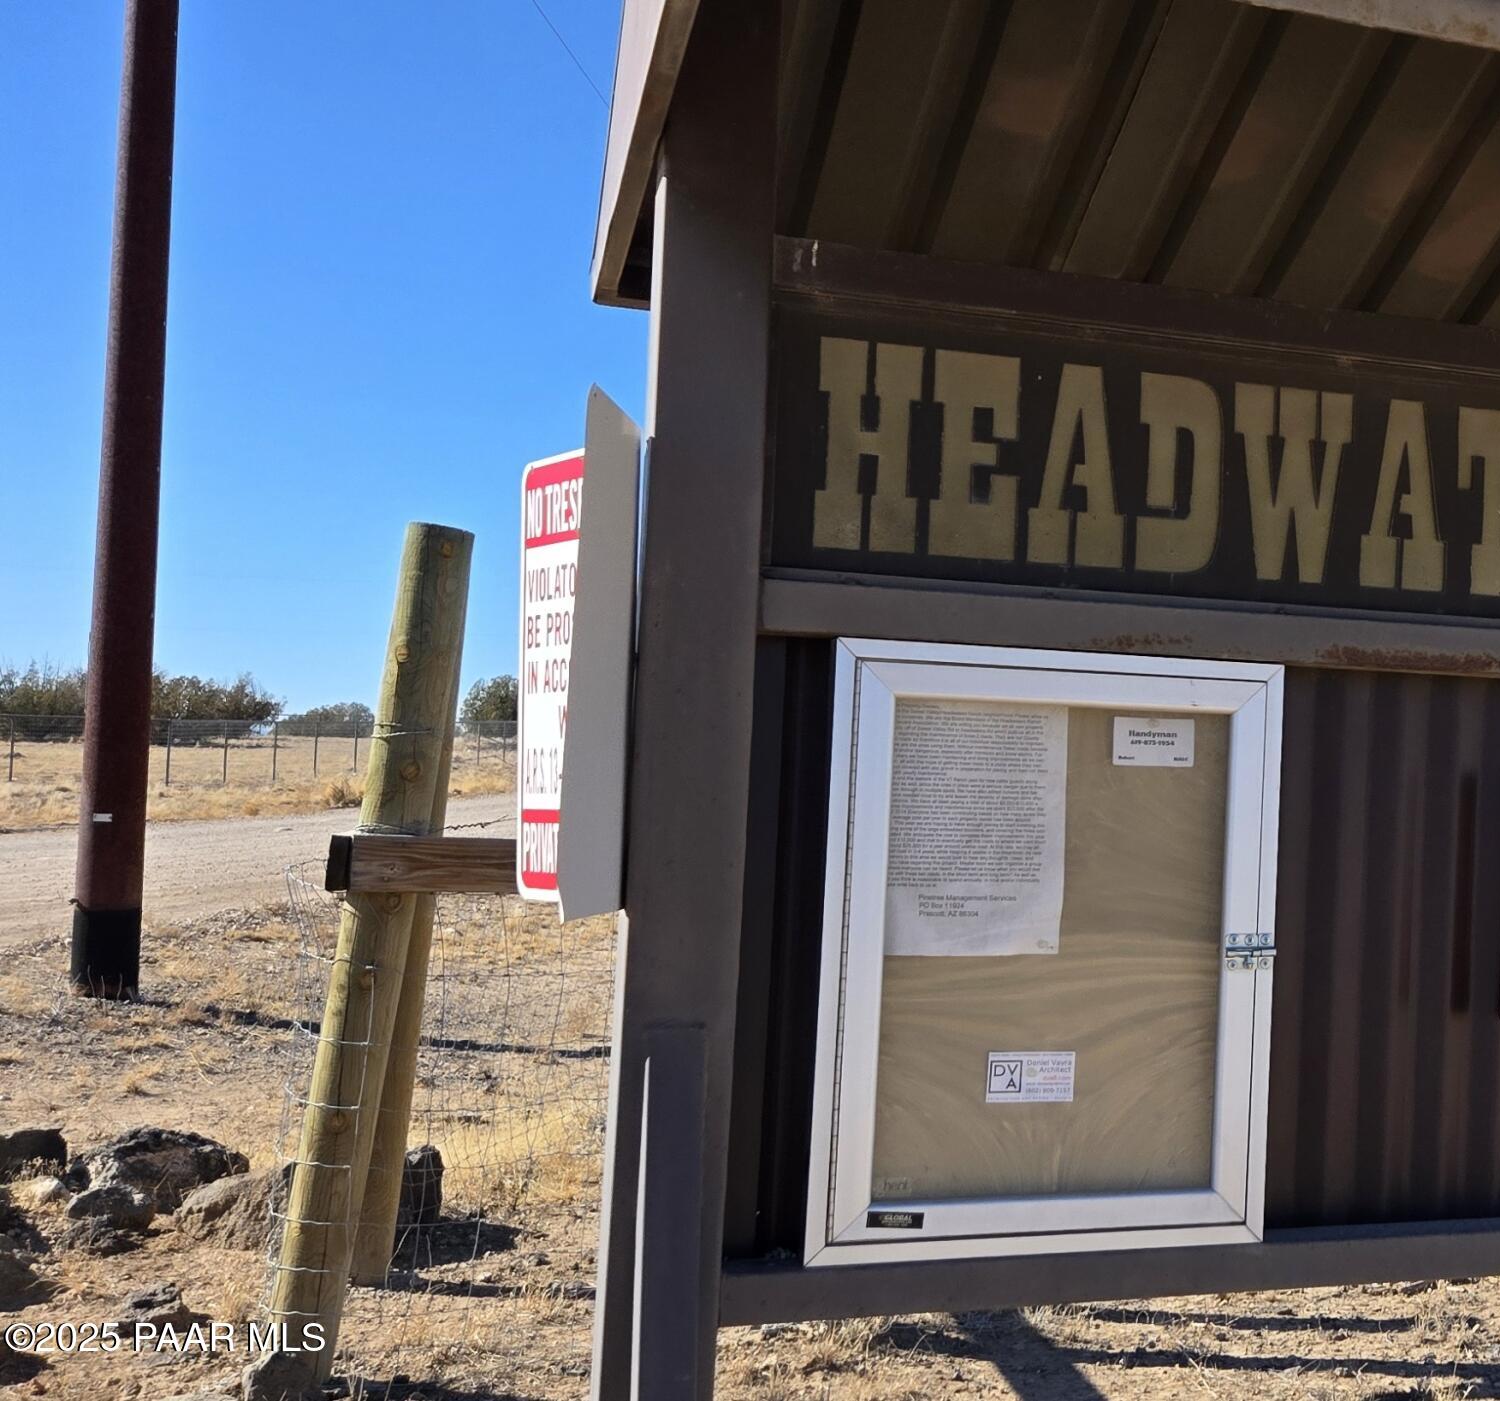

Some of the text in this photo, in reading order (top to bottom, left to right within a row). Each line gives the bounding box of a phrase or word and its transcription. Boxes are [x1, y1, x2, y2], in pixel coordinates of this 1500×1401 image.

[527, 487, 543, 539] NO
[528, 562, 578, 604] VIOLATO
[527, 611, 573, 650] BE PRO
[527, 659, 569, 695] IN ACC
[1128, 729, 1178, 739] Handyman
[550, 748, 563, 794] 13-
[523, 822, 559, 874] PRIVAT
[946, 893, 988, 903] Management
[989, 894, 1017, 902] Services
